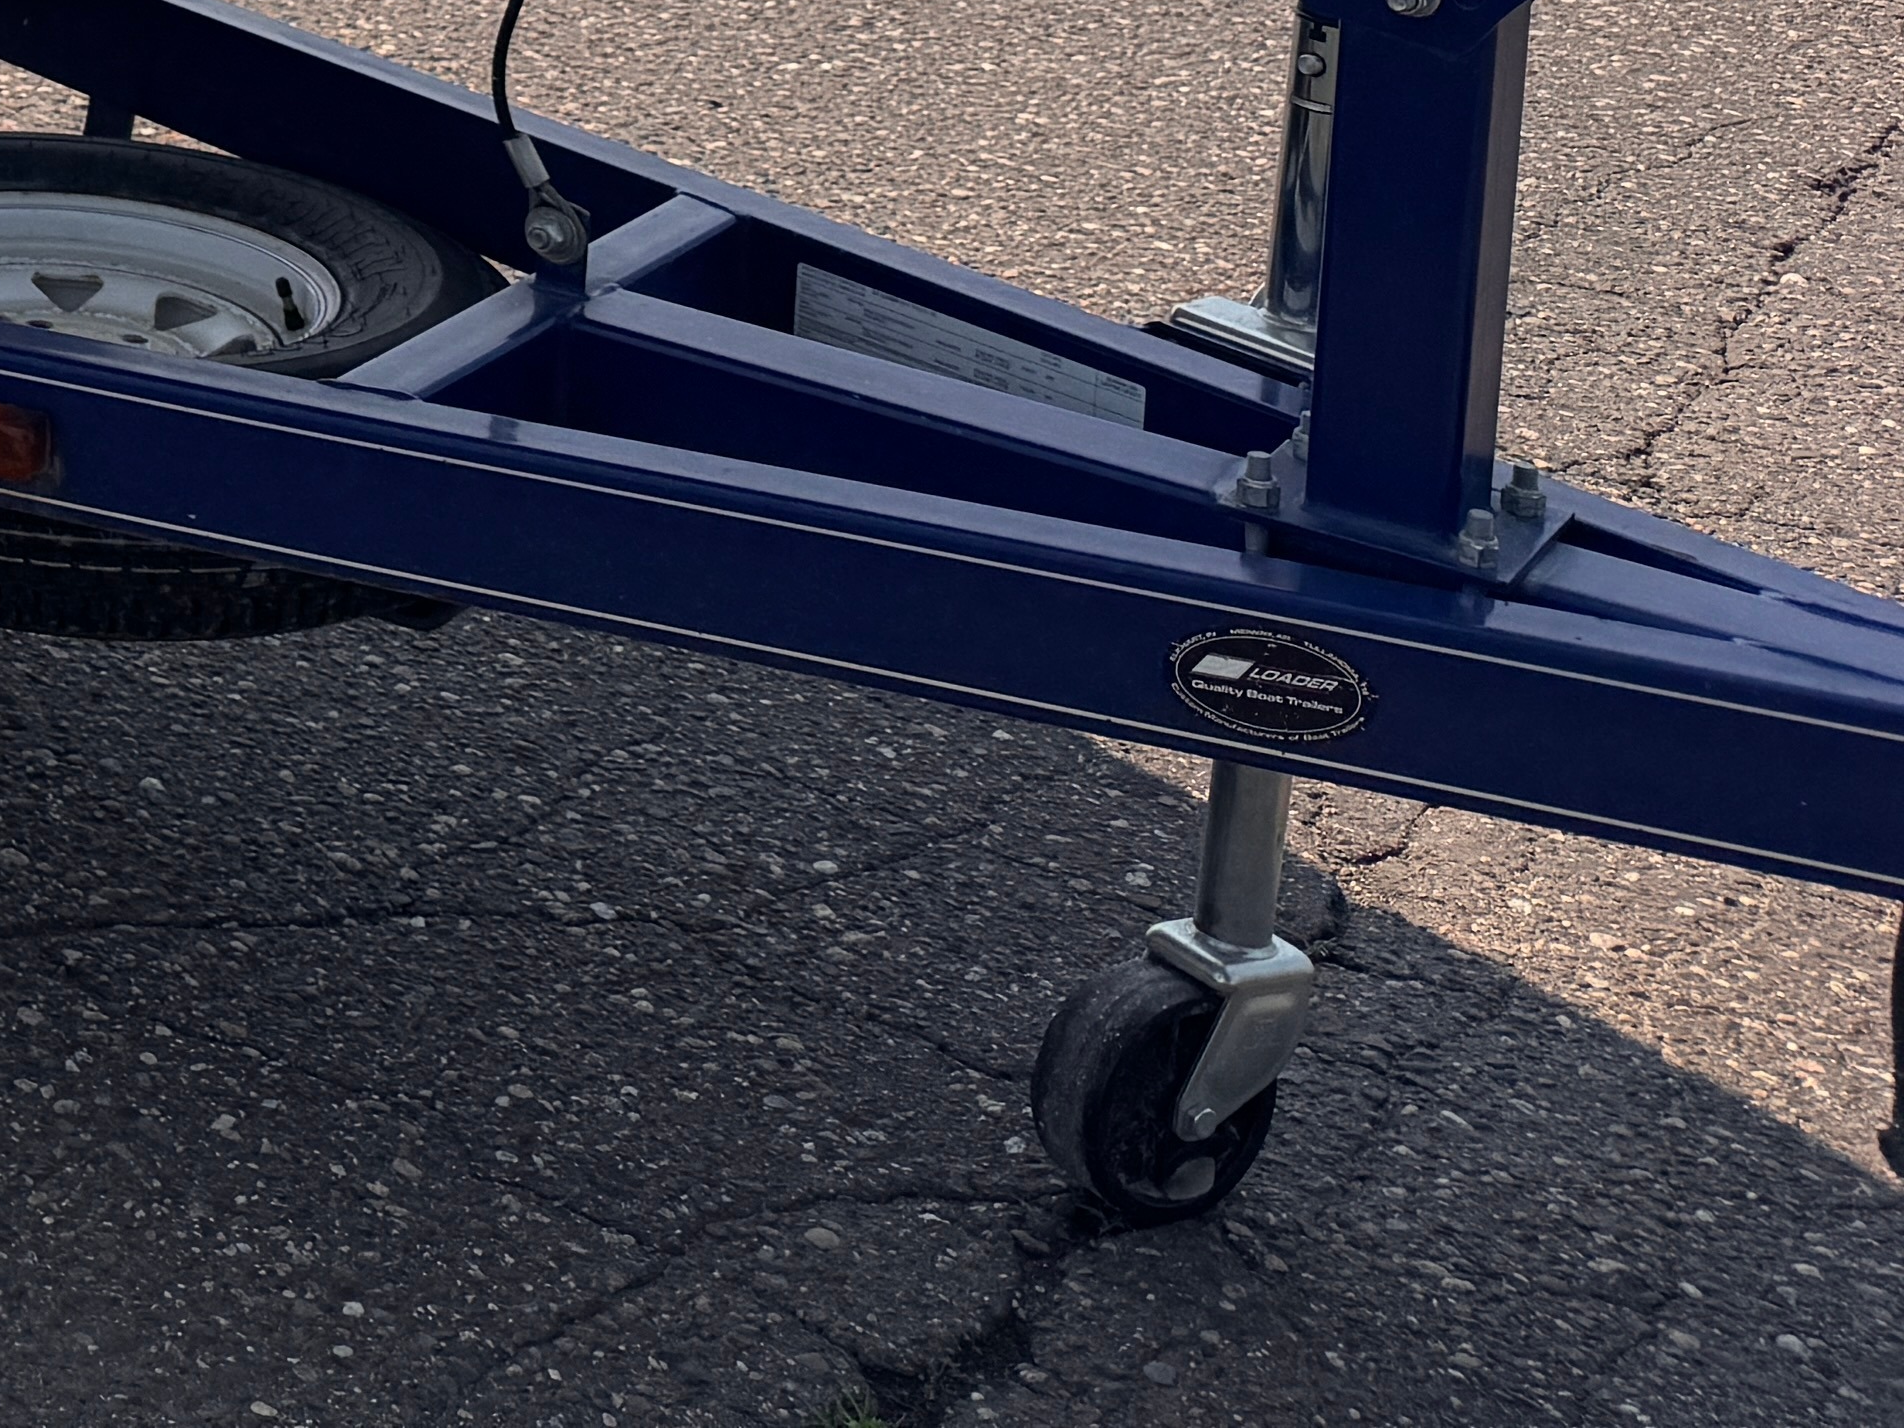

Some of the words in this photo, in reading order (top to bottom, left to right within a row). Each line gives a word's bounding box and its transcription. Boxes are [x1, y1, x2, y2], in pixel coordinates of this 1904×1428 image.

[1249, 667, 1339, 692] LOADER
[1192, 679, 1244, 698] Quality
[1247, 688, 1284, 704] Boat
[1286, 695, 1344, 715] Trailers
